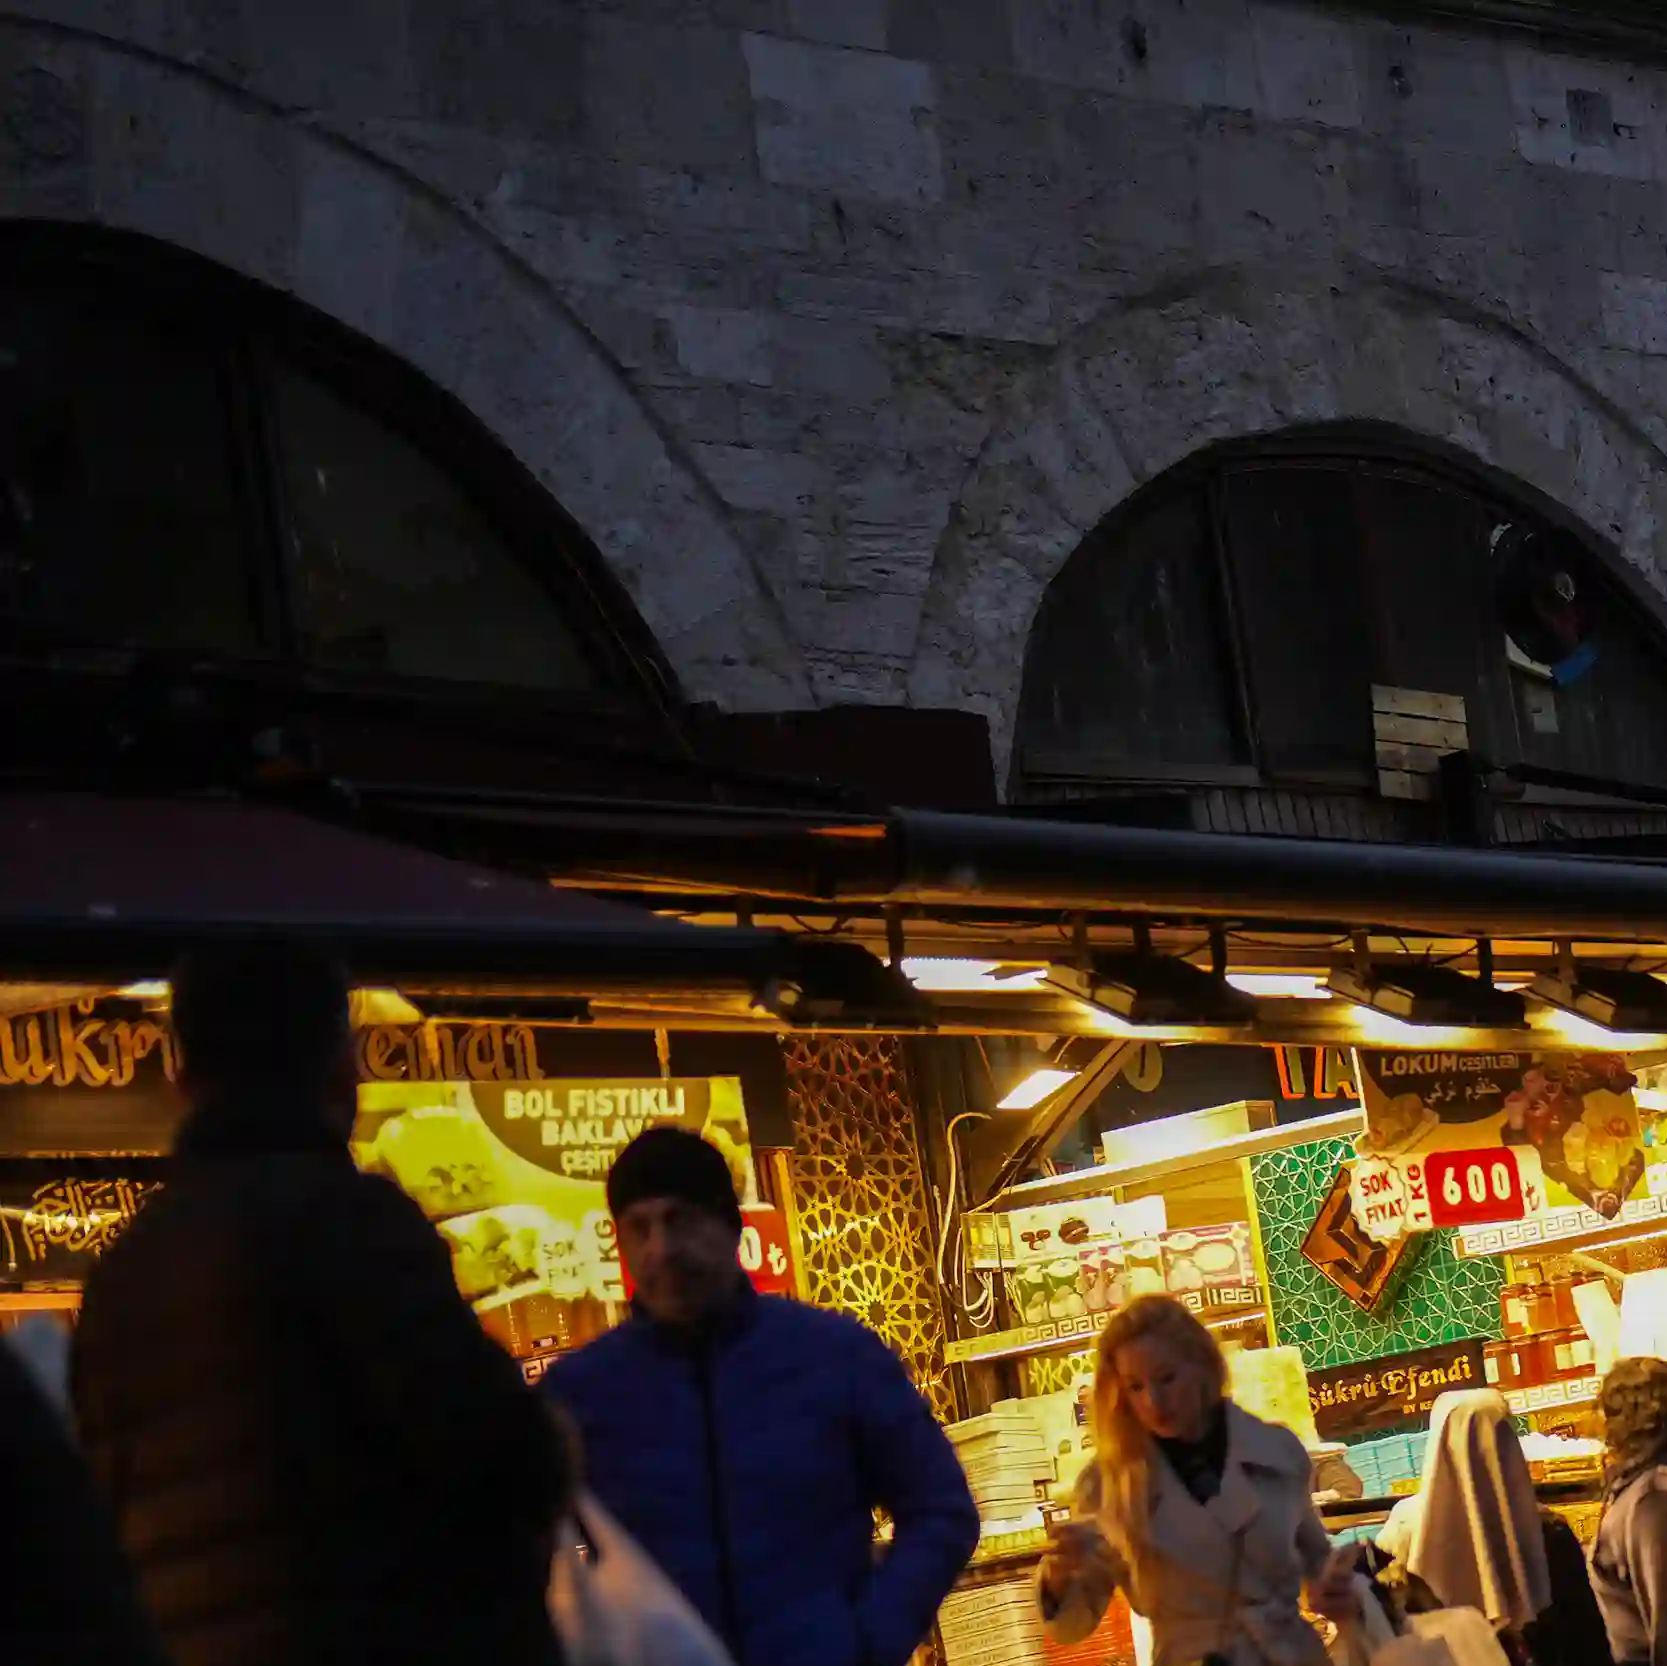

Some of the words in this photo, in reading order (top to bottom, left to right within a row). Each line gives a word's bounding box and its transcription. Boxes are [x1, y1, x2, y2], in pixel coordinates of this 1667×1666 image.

[1380, 1051, 1459, 1078] LOKUM
[504, 1089, 562, 1119] BOL
[569, 1086, 685, 1116] FISTIKLI
[1406, 1163, 1426, 1201] KG
[1442, 1161, 1512, 1206] 600
[1380, 1355, 1474, 1401] Efendi
